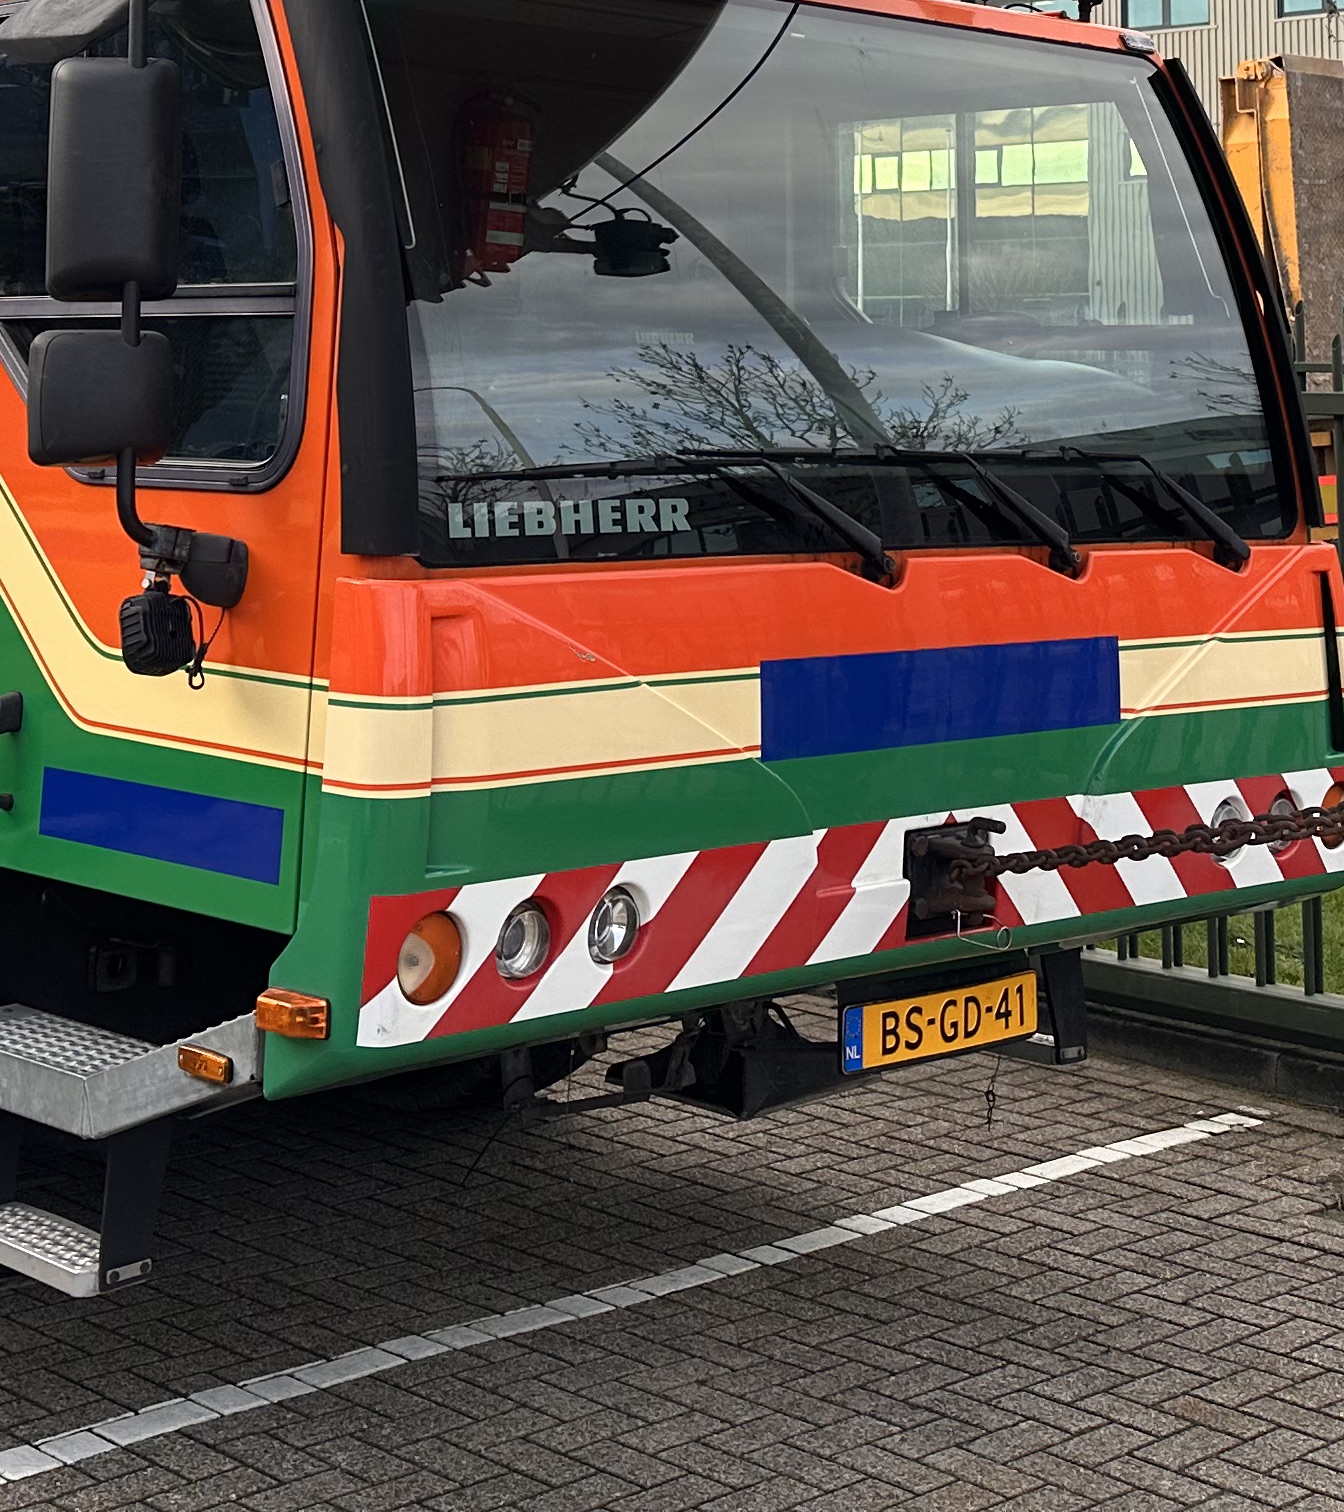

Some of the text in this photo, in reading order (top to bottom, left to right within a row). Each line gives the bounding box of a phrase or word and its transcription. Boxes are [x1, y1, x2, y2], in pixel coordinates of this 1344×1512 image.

[447, 497, 692, 539] LIEBHERR
[880, 984, 1025, 1057] BS-GD-41
[845, 1045, 861, 1061] NL
